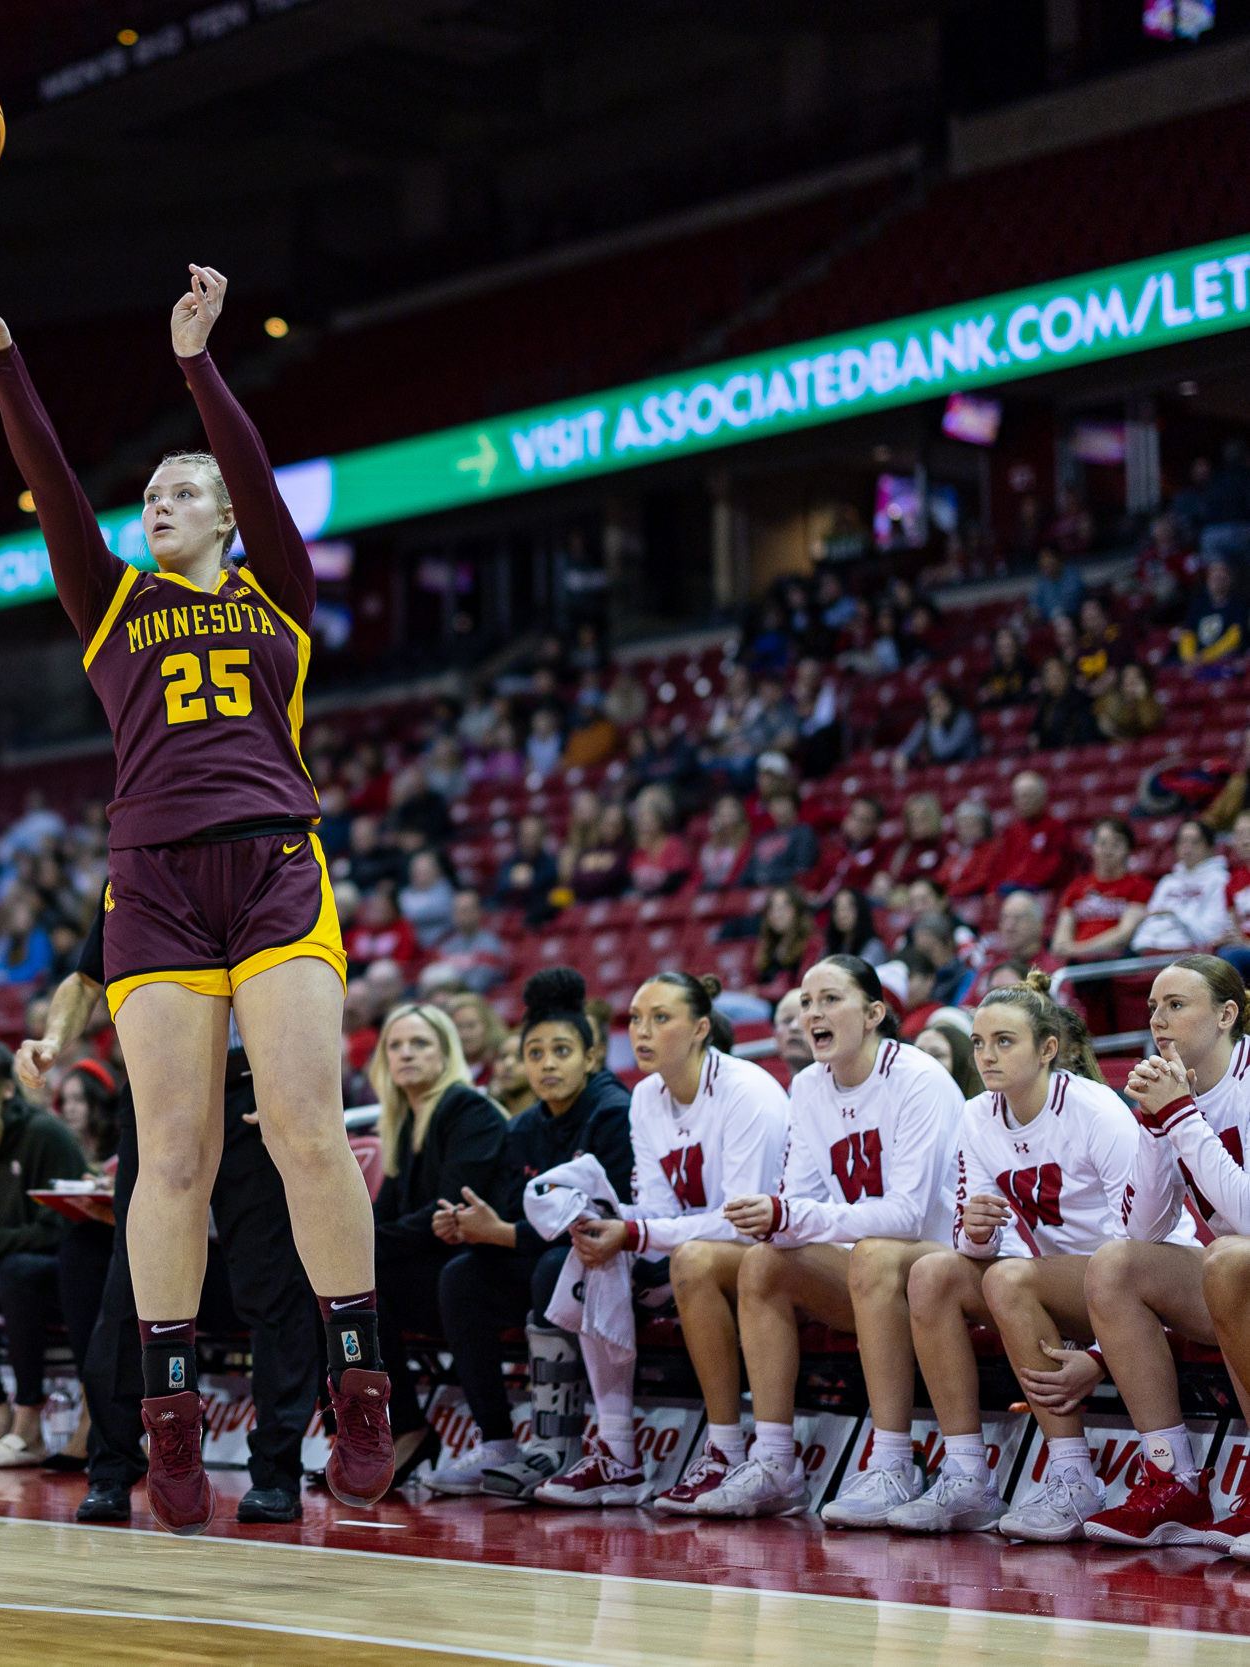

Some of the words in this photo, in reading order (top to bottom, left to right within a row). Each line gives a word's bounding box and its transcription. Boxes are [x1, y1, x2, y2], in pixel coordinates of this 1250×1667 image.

[512, 410, 605, 471] VISIT
[614, 253, 1250, 450] ASSOCIATEDBANK.COM/LET
[126, 602, 276, 653] MINNESOTA
[160, 648, 253, 725] 25
[830, 1128, 883, 1205] W
[996, 1162, 1064, 1232] W
